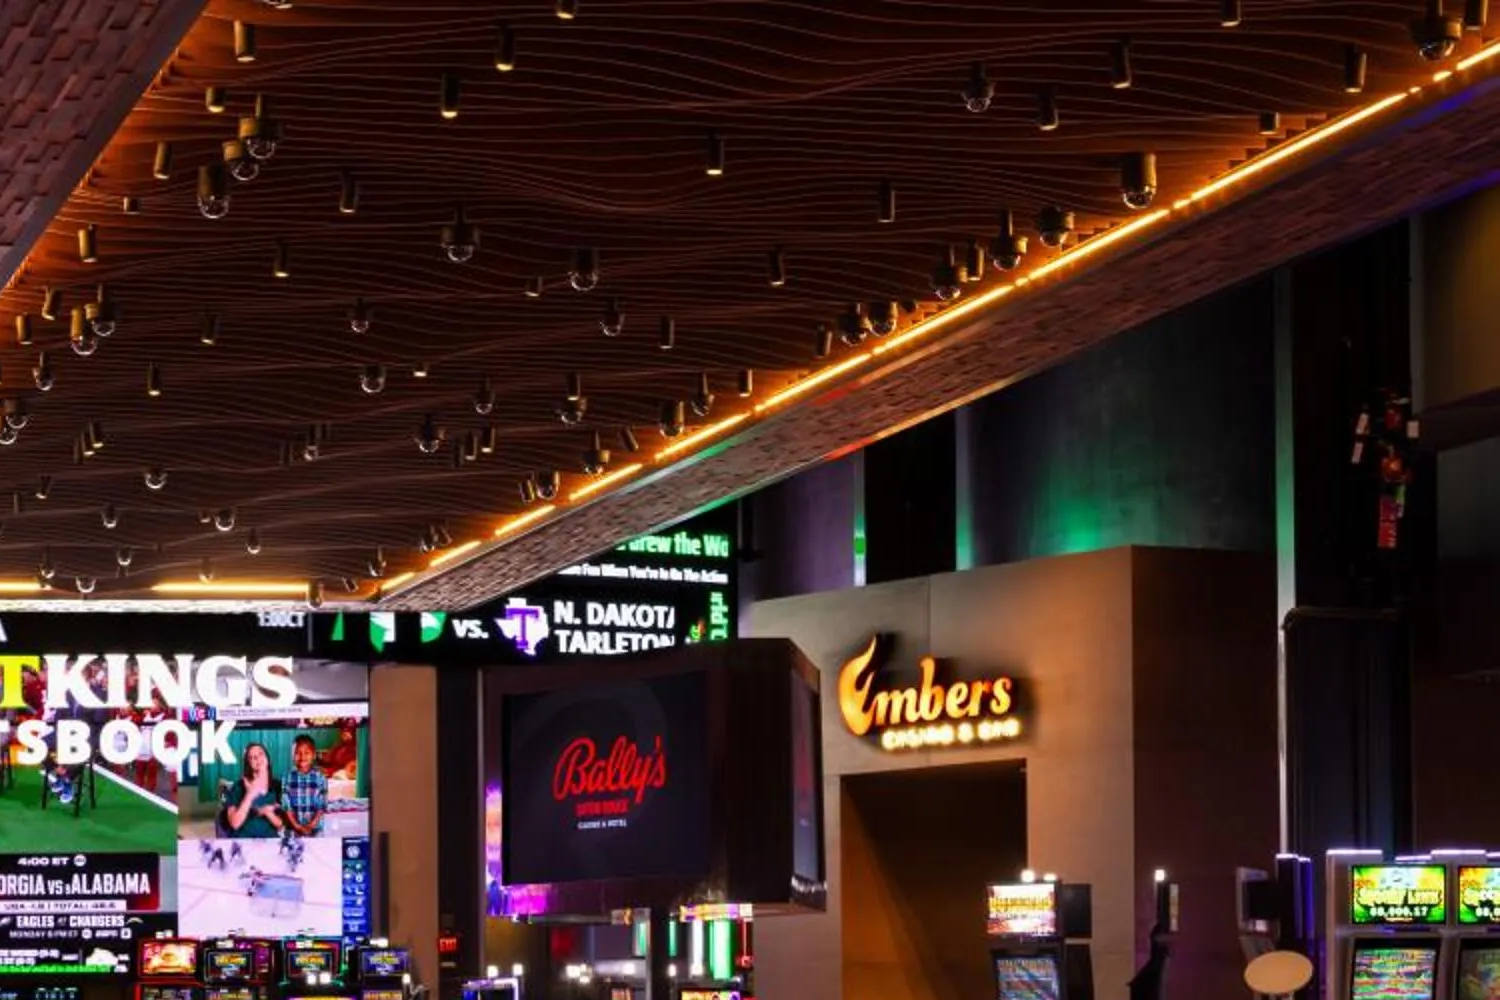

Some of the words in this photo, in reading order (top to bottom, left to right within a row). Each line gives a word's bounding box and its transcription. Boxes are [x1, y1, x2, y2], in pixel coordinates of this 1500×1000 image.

[674, 532, 701, 555] the
[554, 600, 582, 624] N.
[452, 618, 489, 639] VS.
[838, 635, 1012, 736] Embers
[553, 735, 666, 804] Bally's
[17, 857, 50, 867] 4:00
[52, 857, 70, 867] ET
[71, 872, 151, 895] ALABAMA
[16, 915, 55, 928] EAGLES
[69, 915, 125, 928] CHARGERS
